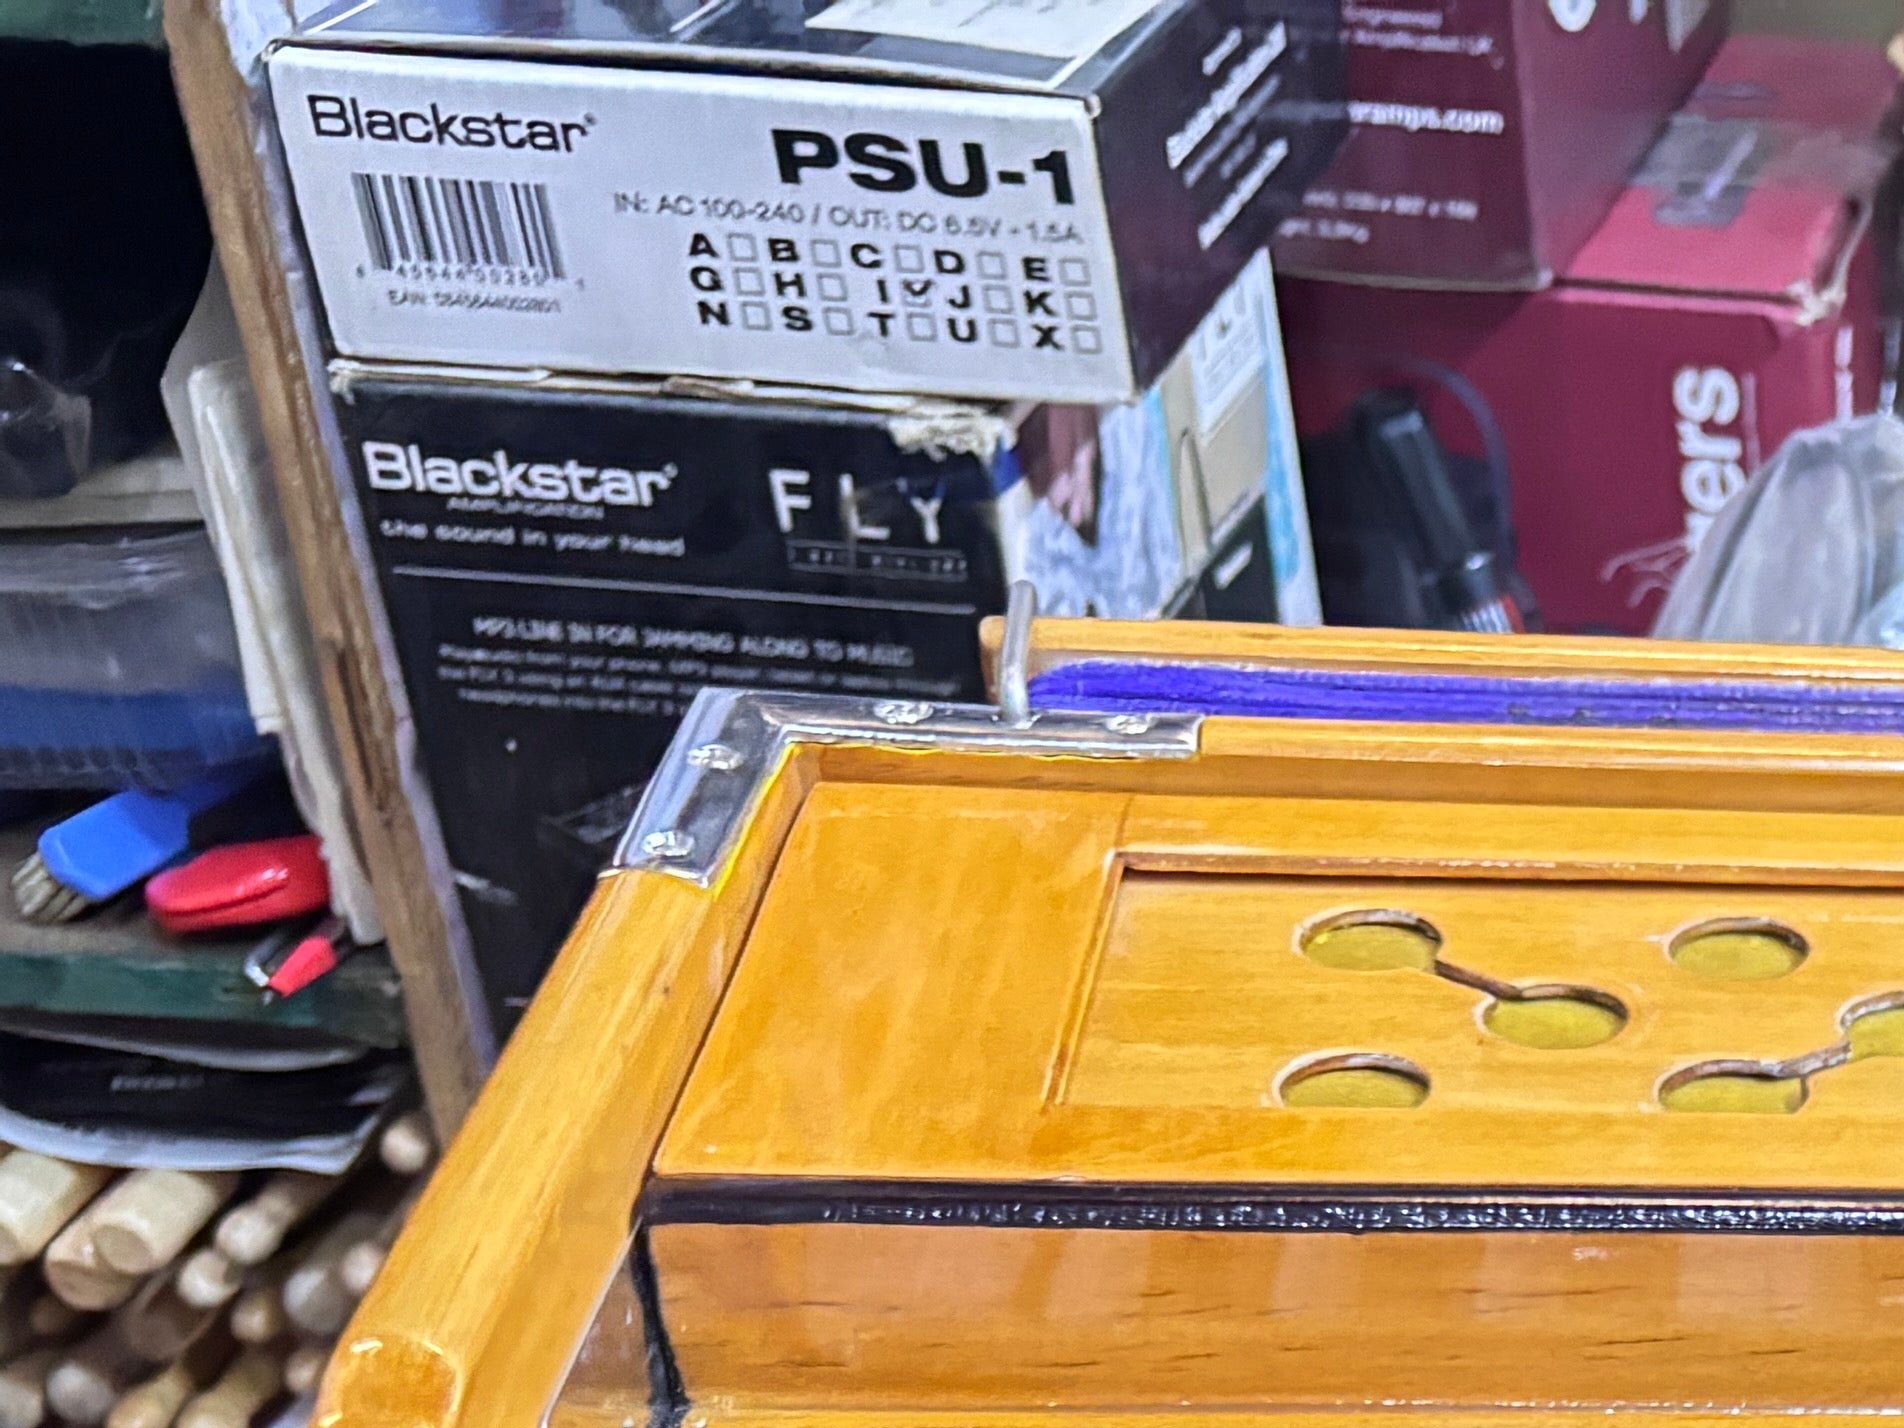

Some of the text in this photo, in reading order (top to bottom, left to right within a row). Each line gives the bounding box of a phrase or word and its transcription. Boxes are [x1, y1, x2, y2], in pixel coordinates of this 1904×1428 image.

[306, 94, 591, 153] Blackstar
[770, 128, 1075, 205] PSU-1
[656, 194, 694, 217] AC
[702, 197, 803, 225] 100-240
[899, 210, 937, 235] DC
[689, 232, 1052, 282] A B C D E
[773, 272, 807, 299] H
[877, 280, 888, 303] I
[948, 286, 970, 310] J
[1024, 290, 1057, 317] K
[697, 300, 1065, 351] N S T U X
[361, 440, 672, 507] Blackstar
[433, 522, 516, 546] sound
[520, 527, 549, 547] in
